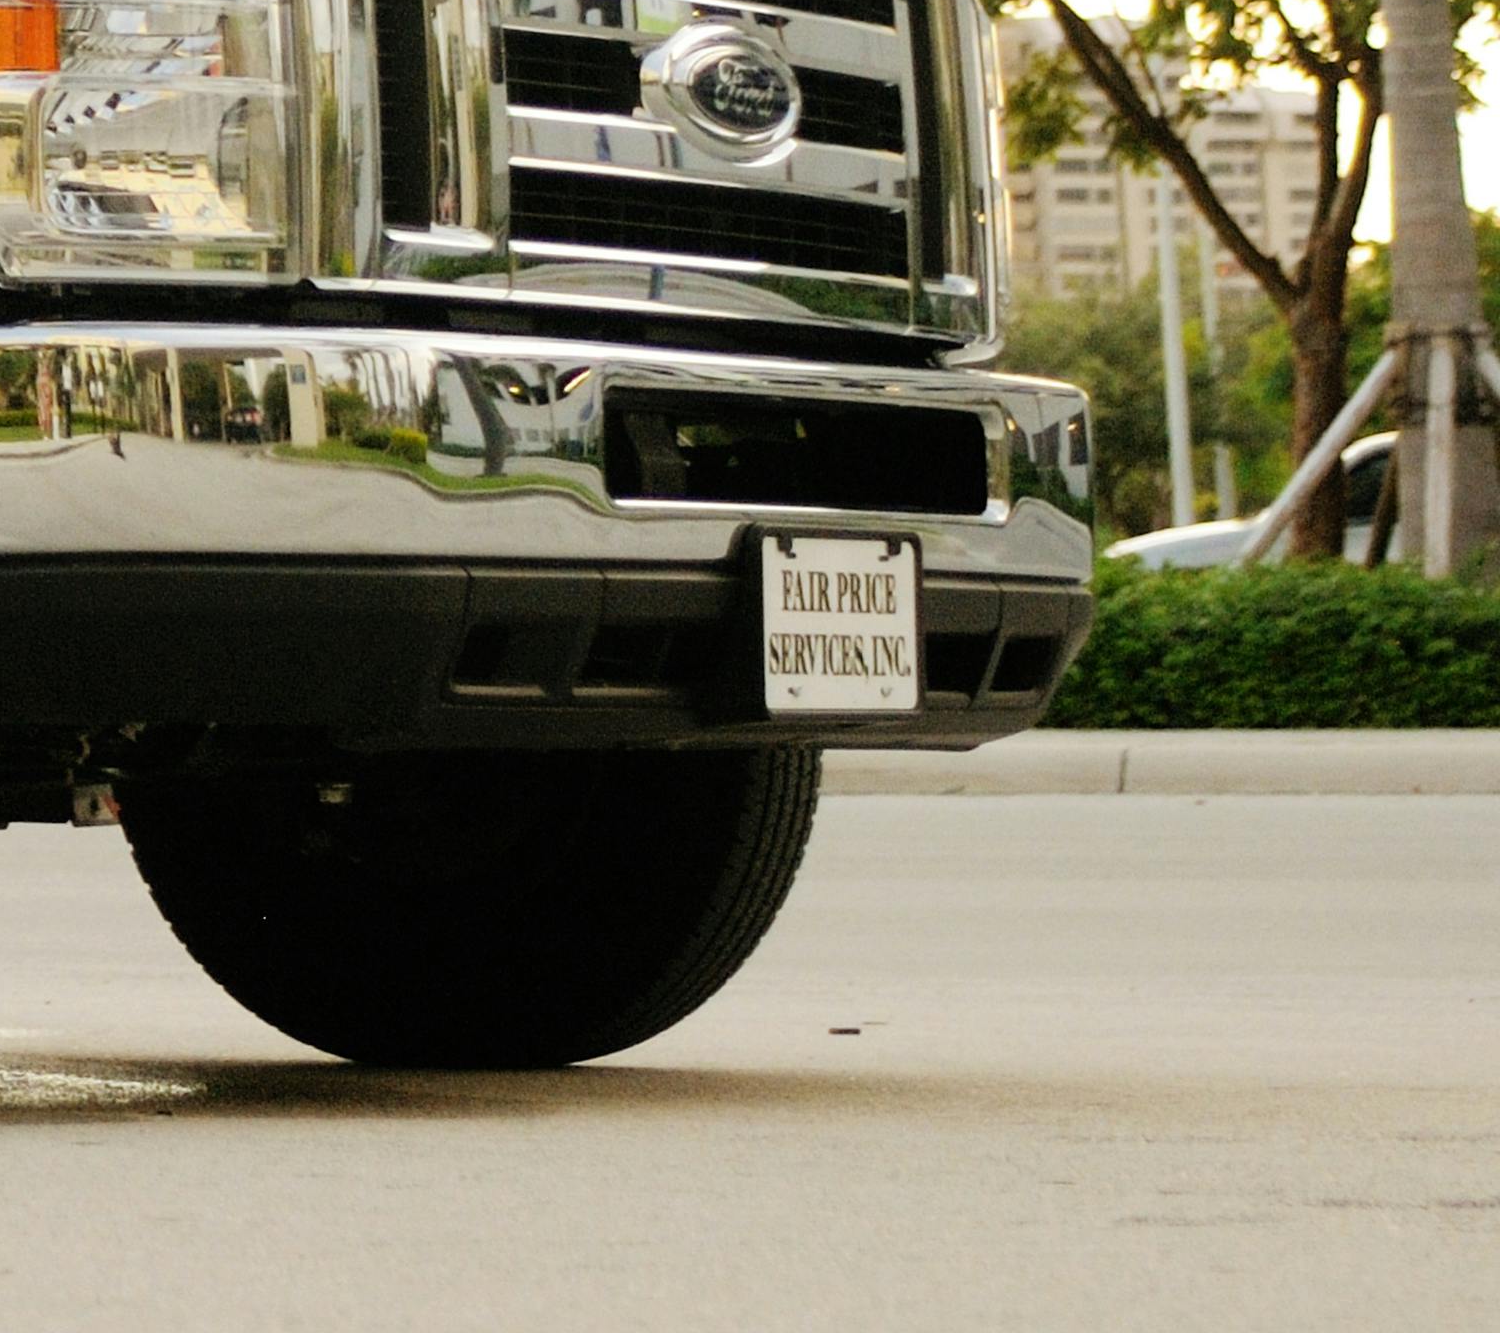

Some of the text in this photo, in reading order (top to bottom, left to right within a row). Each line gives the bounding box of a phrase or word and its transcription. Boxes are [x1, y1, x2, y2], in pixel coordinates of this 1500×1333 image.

[713, 58, 775, 118] Ford
[781, 569, 897, 615] FAIR PRICE
[769, 633, 911, 680] SERVICES, INC.
